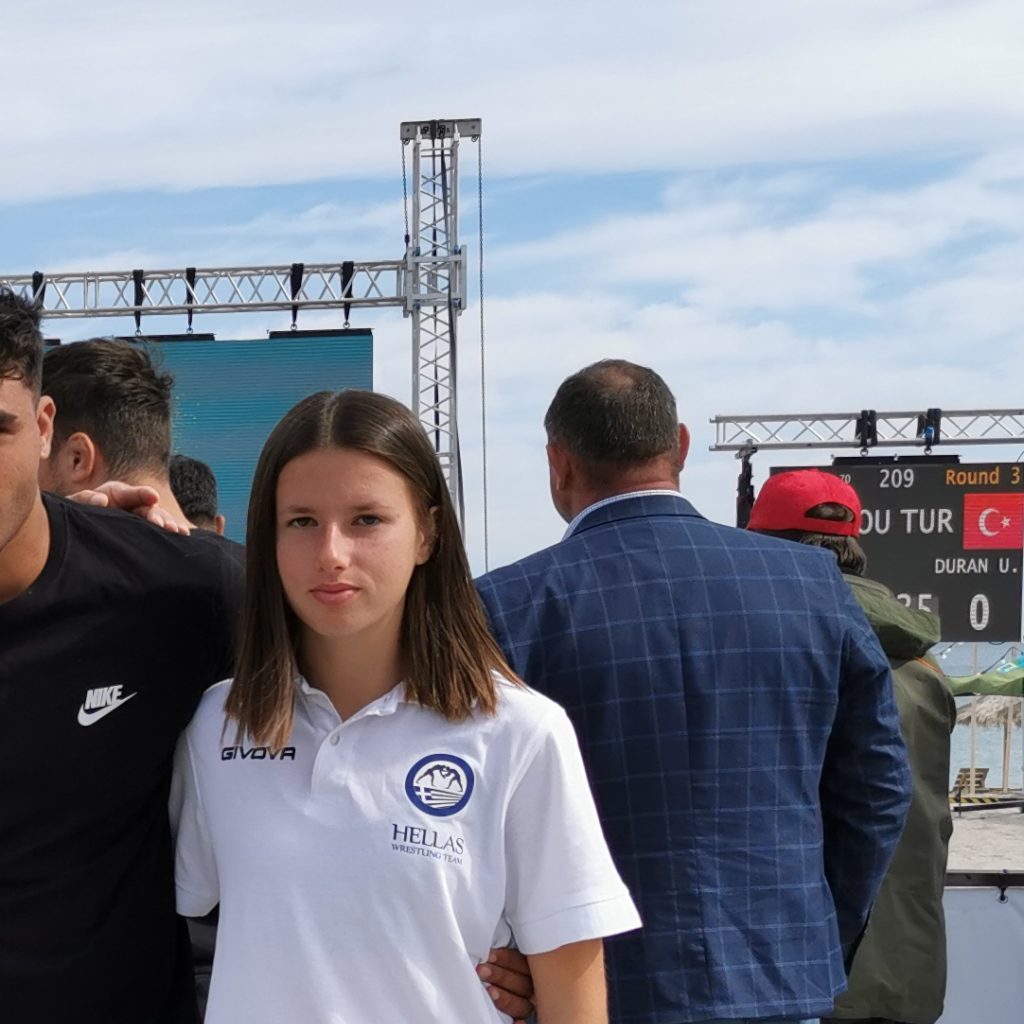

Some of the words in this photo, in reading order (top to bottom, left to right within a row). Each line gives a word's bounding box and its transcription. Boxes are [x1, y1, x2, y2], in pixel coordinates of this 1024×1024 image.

[879, 468, 914, 488] 209
[945, 466, 1000, 485] Round
[1010, 467, 1020, 485] 3
[858, 509, 891, 535] OU
[900, 508, 954, 534] TUR
[935, 558, 988, 574] DURAN
[999, 558, 1017, 574] U.
[970, 594, 989, 630] 0
[84, 684, 123, 710] NIKE
[221, 746, 296, 761] GIVOVA
[392, 823, 464, 855] HELLAS
[391, 843, 442, 859] WRESTLING
[443, 853, 463, 865] TEAM
